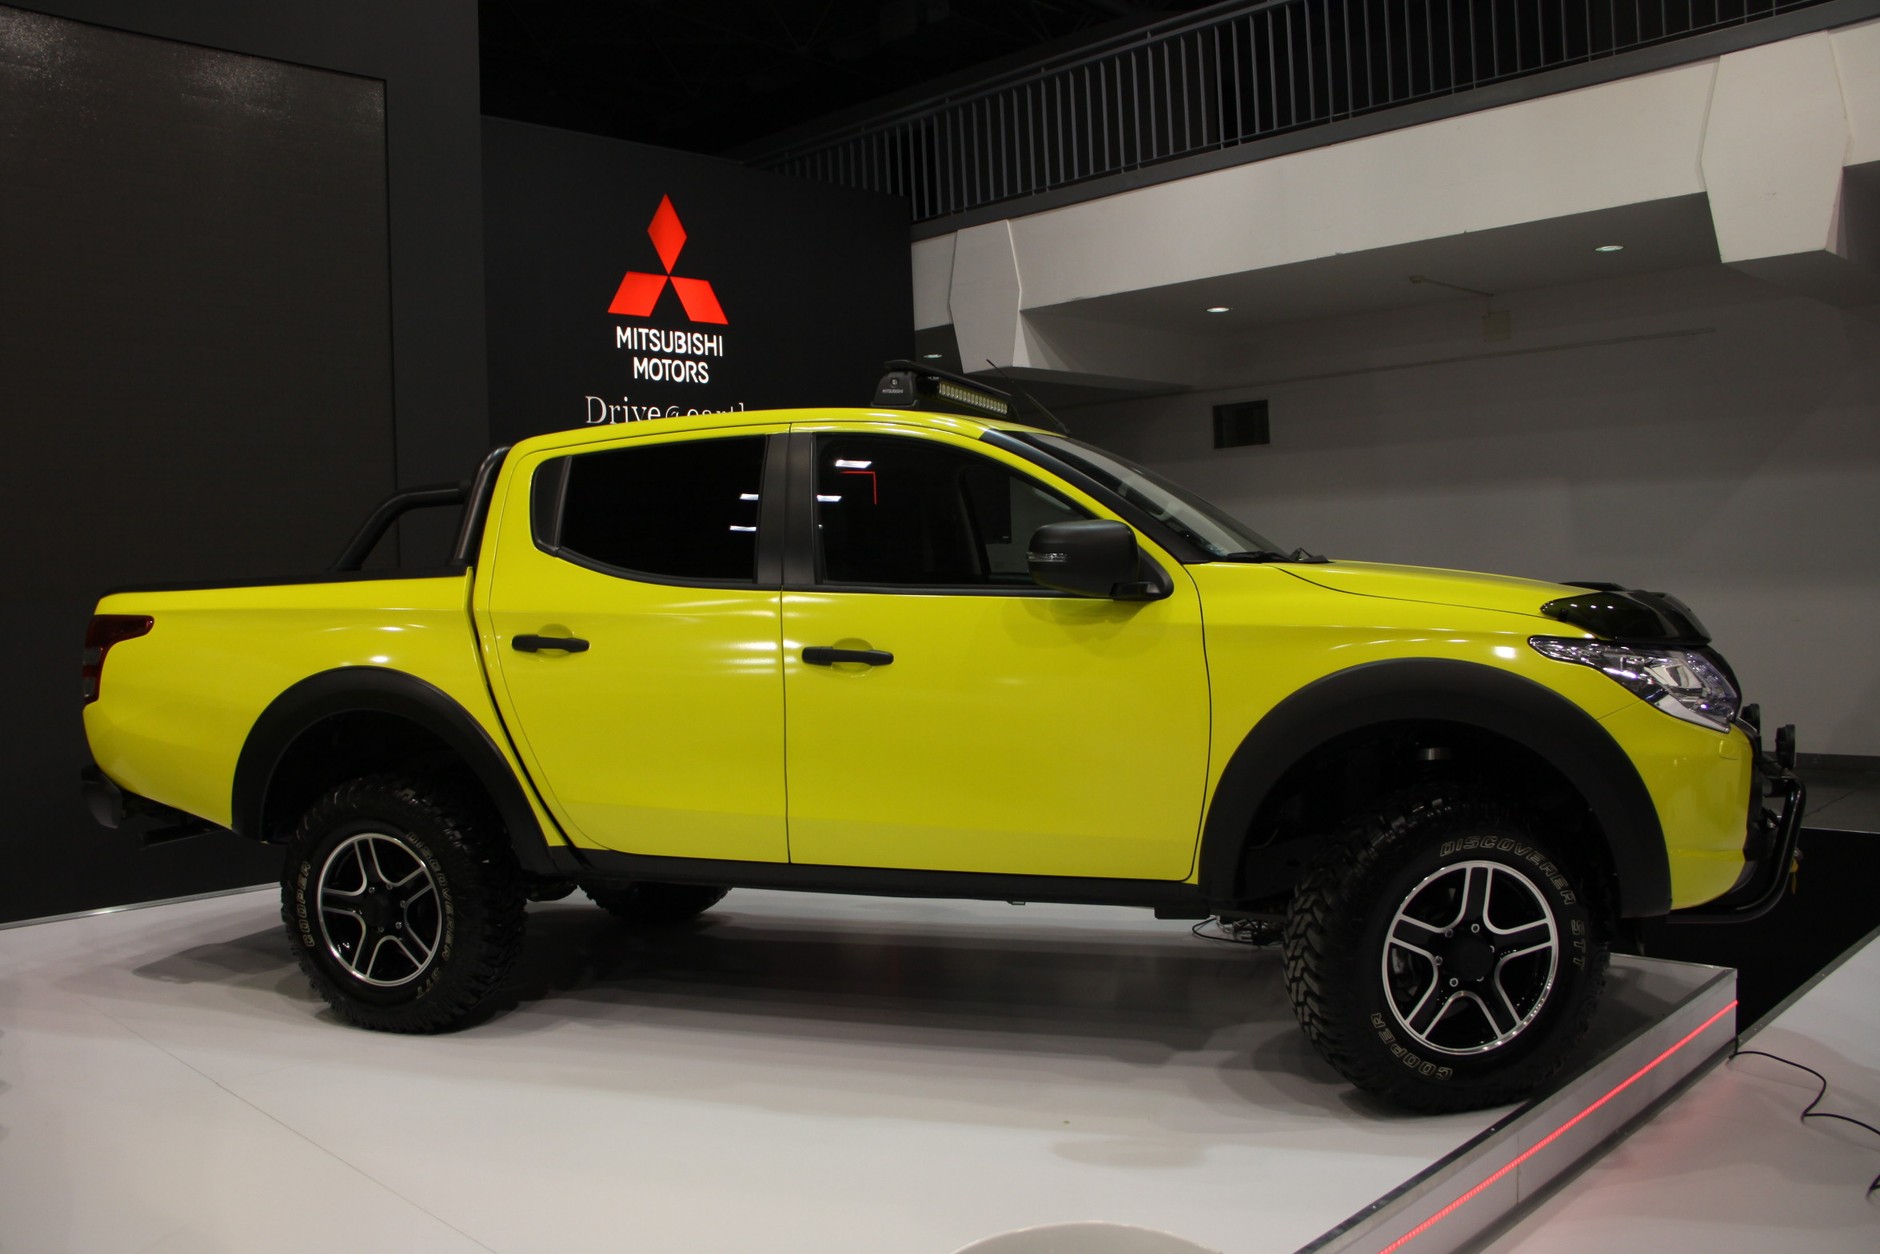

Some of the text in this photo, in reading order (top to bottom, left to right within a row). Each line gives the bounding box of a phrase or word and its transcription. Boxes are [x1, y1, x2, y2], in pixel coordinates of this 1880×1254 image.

[616, 325, 724, 357] MITSUBISHI
[632, 356, 710, 384] MOTORS
[296, 860, 316, 948] COOPER
[1439, 835, 1587, 969] DISCOVERER STT
[1369, 1012, 1454, 1081] COOPER
